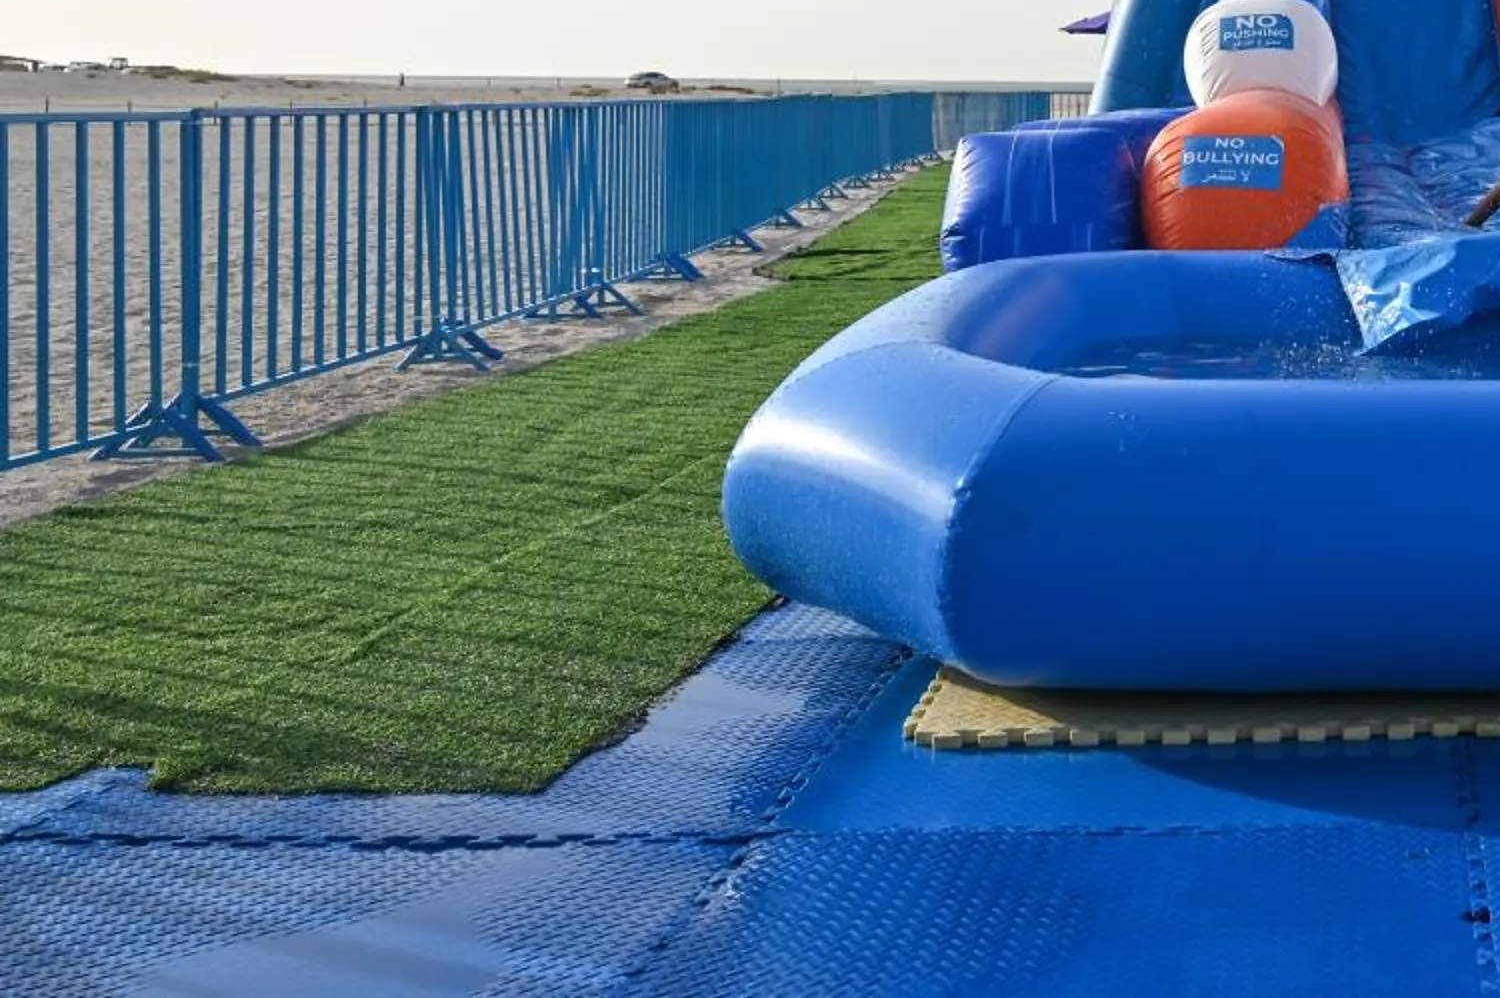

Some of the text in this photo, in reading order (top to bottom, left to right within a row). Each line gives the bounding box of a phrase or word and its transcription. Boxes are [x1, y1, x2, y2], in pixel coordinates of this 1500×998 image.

[1235, 15, 1277, 29] NO
[1223, 28, 1288, 41] PUSHING
[1216, 138, 1244, 148] NO
[1183, 151, 1279, 165] BULLYING
